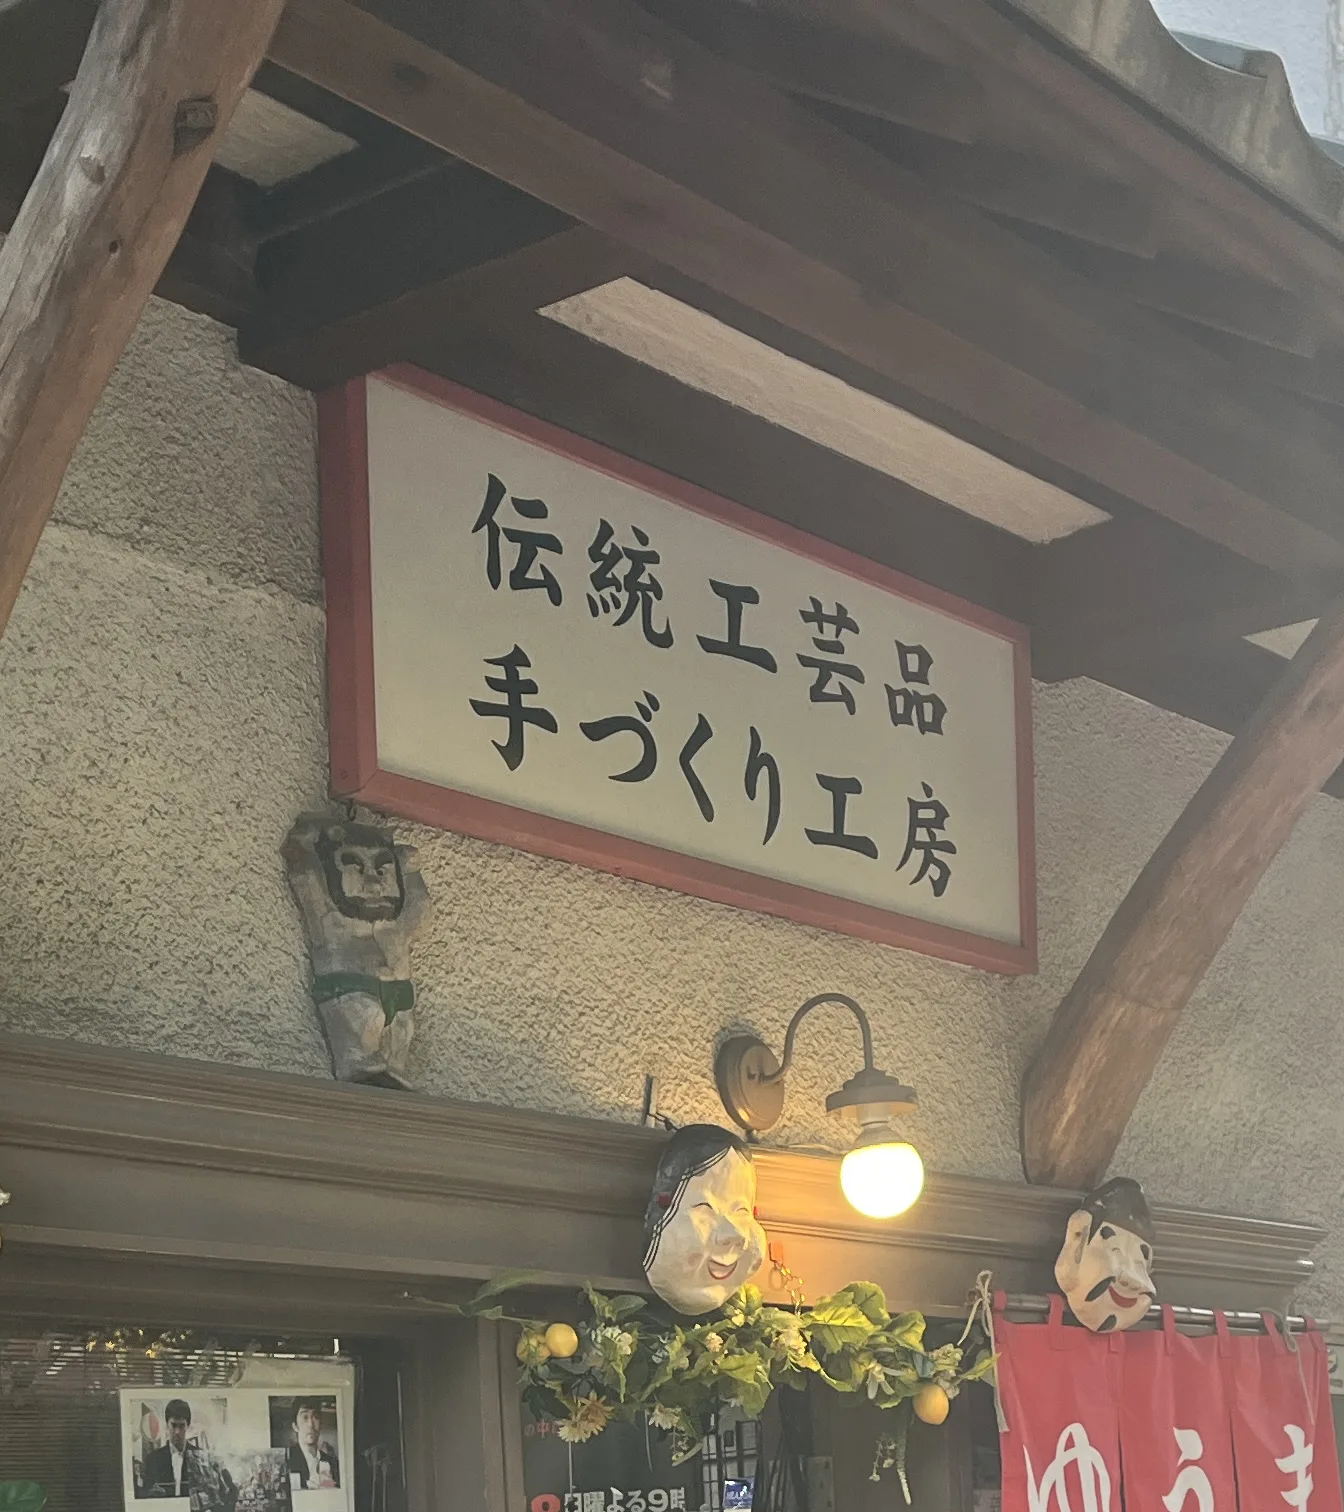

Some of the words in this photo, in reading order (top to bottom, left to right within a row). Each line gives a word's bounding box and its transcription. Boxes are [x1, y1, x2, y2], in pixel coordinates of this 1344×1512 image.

[471, 472, 948, 736] 伝統工芸品
[468, 643, 957, 897] 手づくり工房
